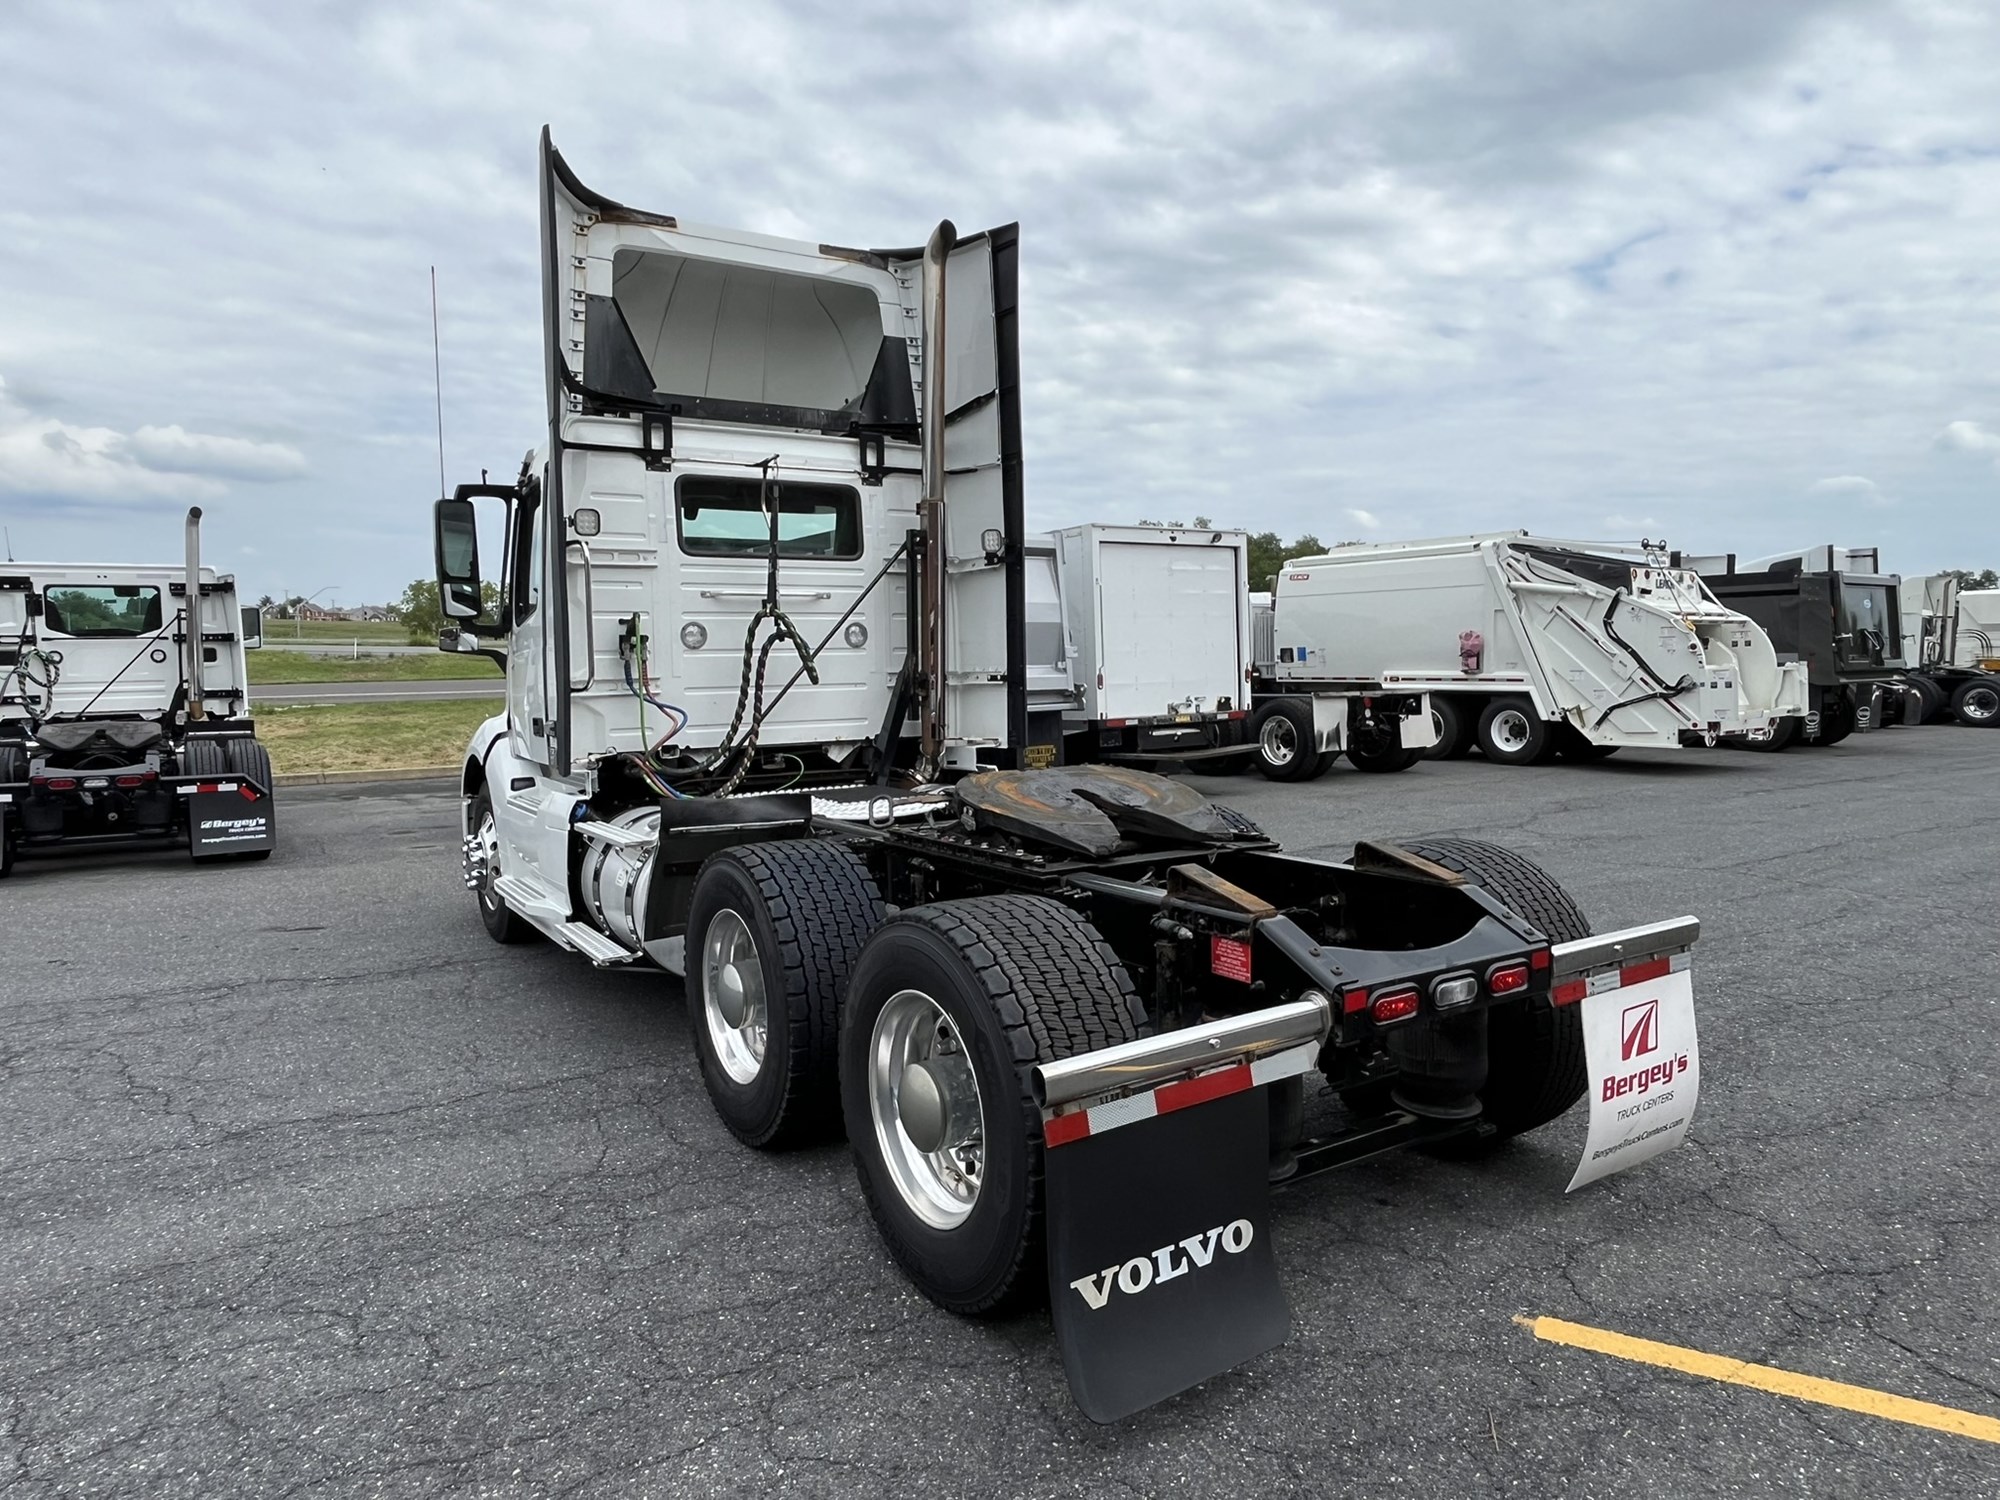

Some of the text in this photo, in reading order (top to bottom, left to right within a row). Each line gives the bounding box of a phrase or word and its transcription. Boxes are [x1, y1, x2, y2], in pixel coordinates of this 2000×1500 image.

[213, 817, 266, 828] Bergey's
[1602, 1052, 1689, 1103] Bergey's
[1617, 1090, 1675, 1122] TRUCK CENTERS
[1069, 1218, 1255, 1311] VOLVO
